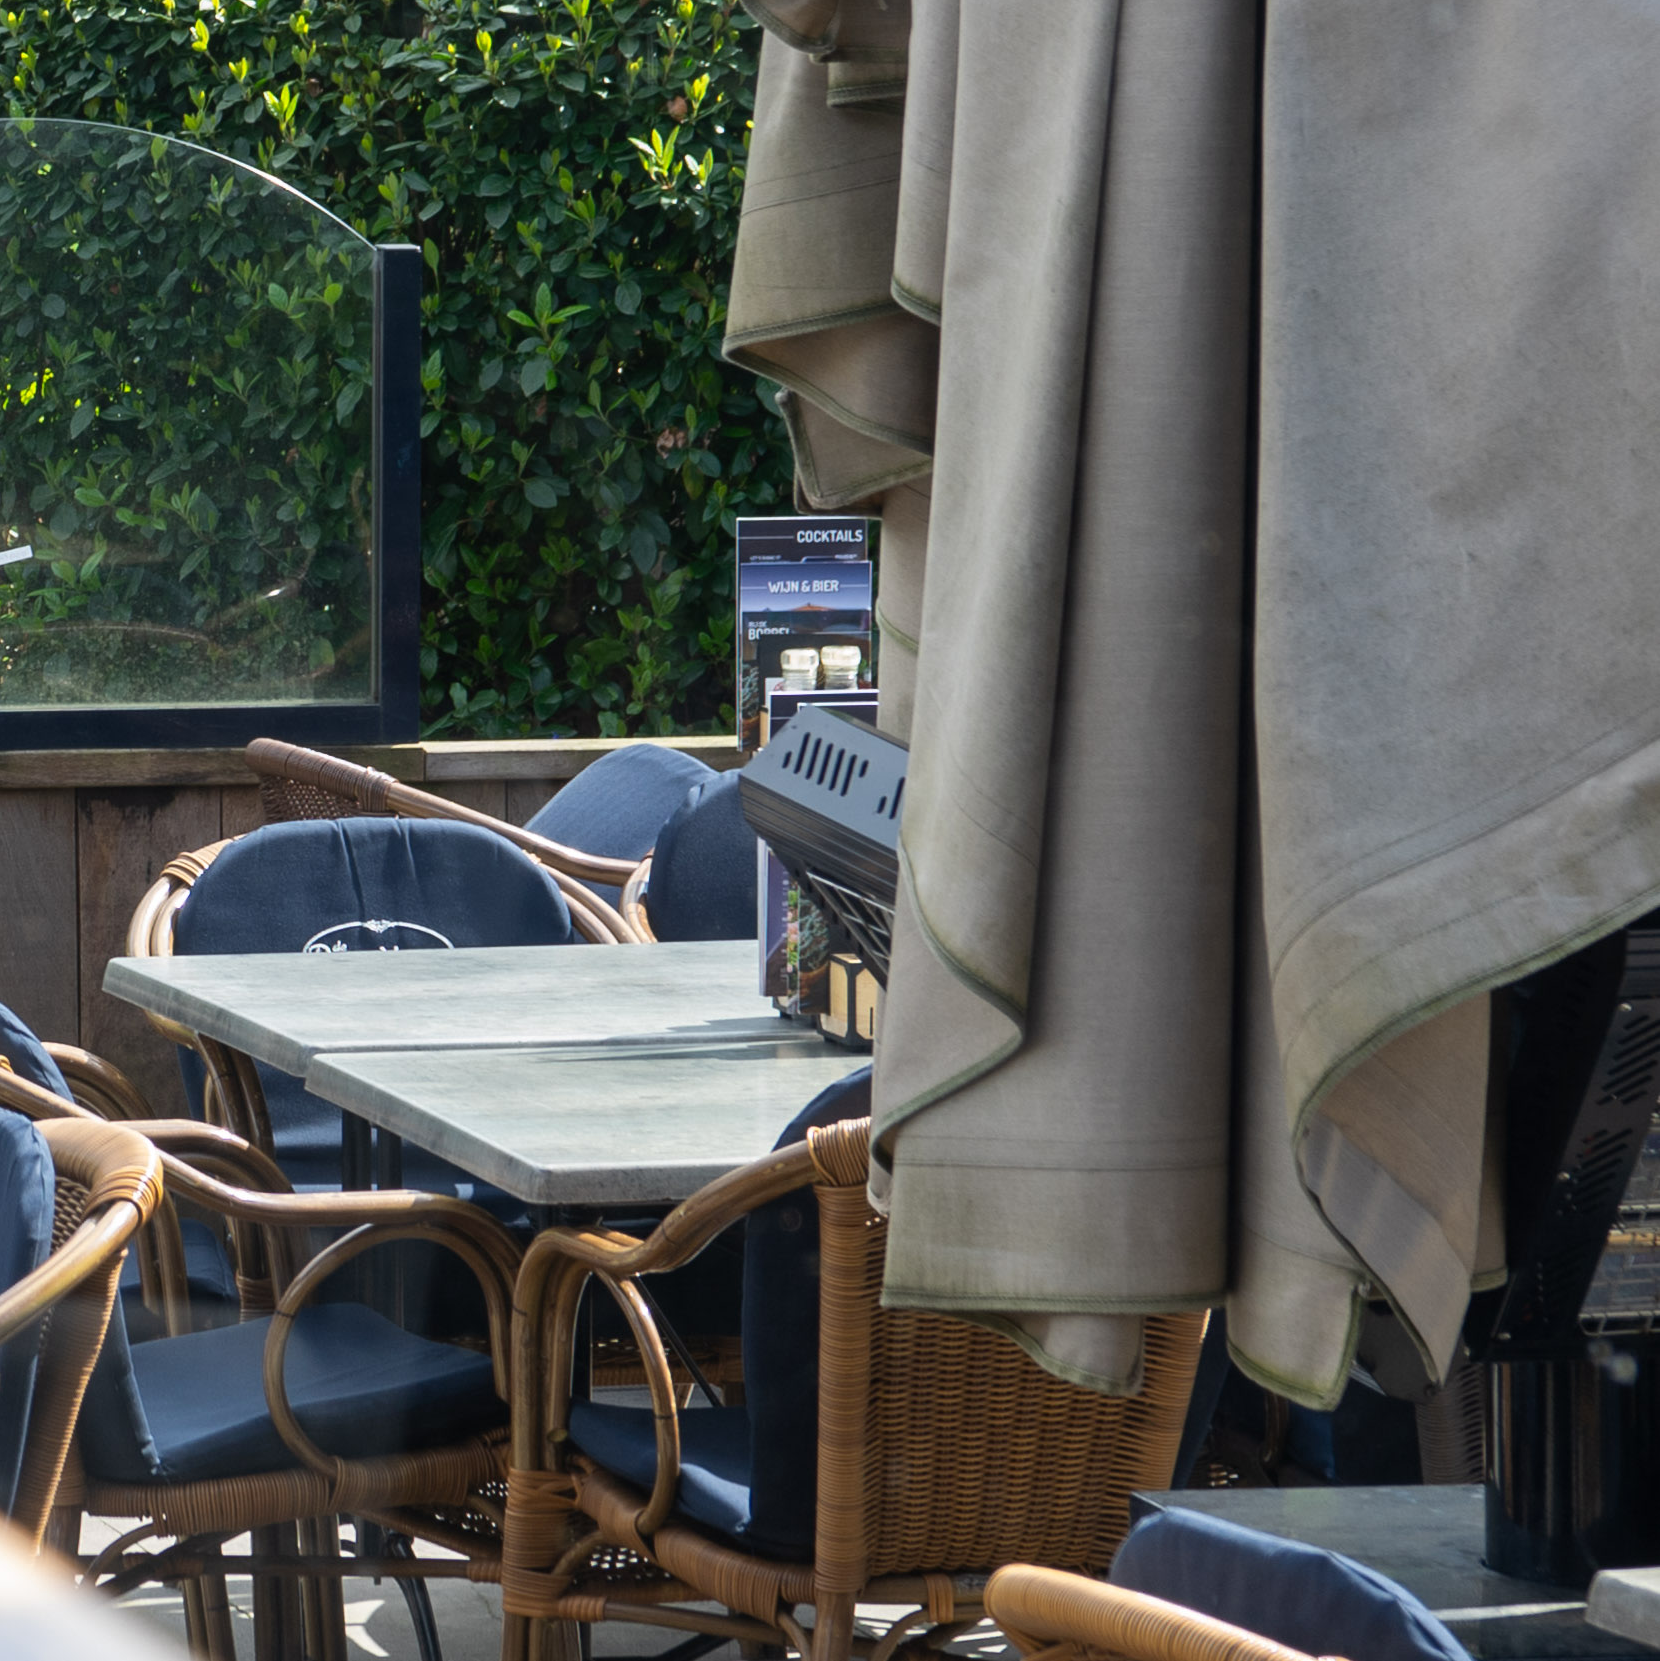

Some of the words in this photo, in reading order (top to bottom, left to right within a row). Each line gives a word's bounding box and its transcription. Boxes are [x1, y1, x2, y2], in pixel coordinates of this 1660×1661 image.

[796, 529, 864, 543] COCKTAILS
[767, 580, 799, 594] WIJN
[801, 580, 811, 593] &
[812, 579, 840, 593] BIER
